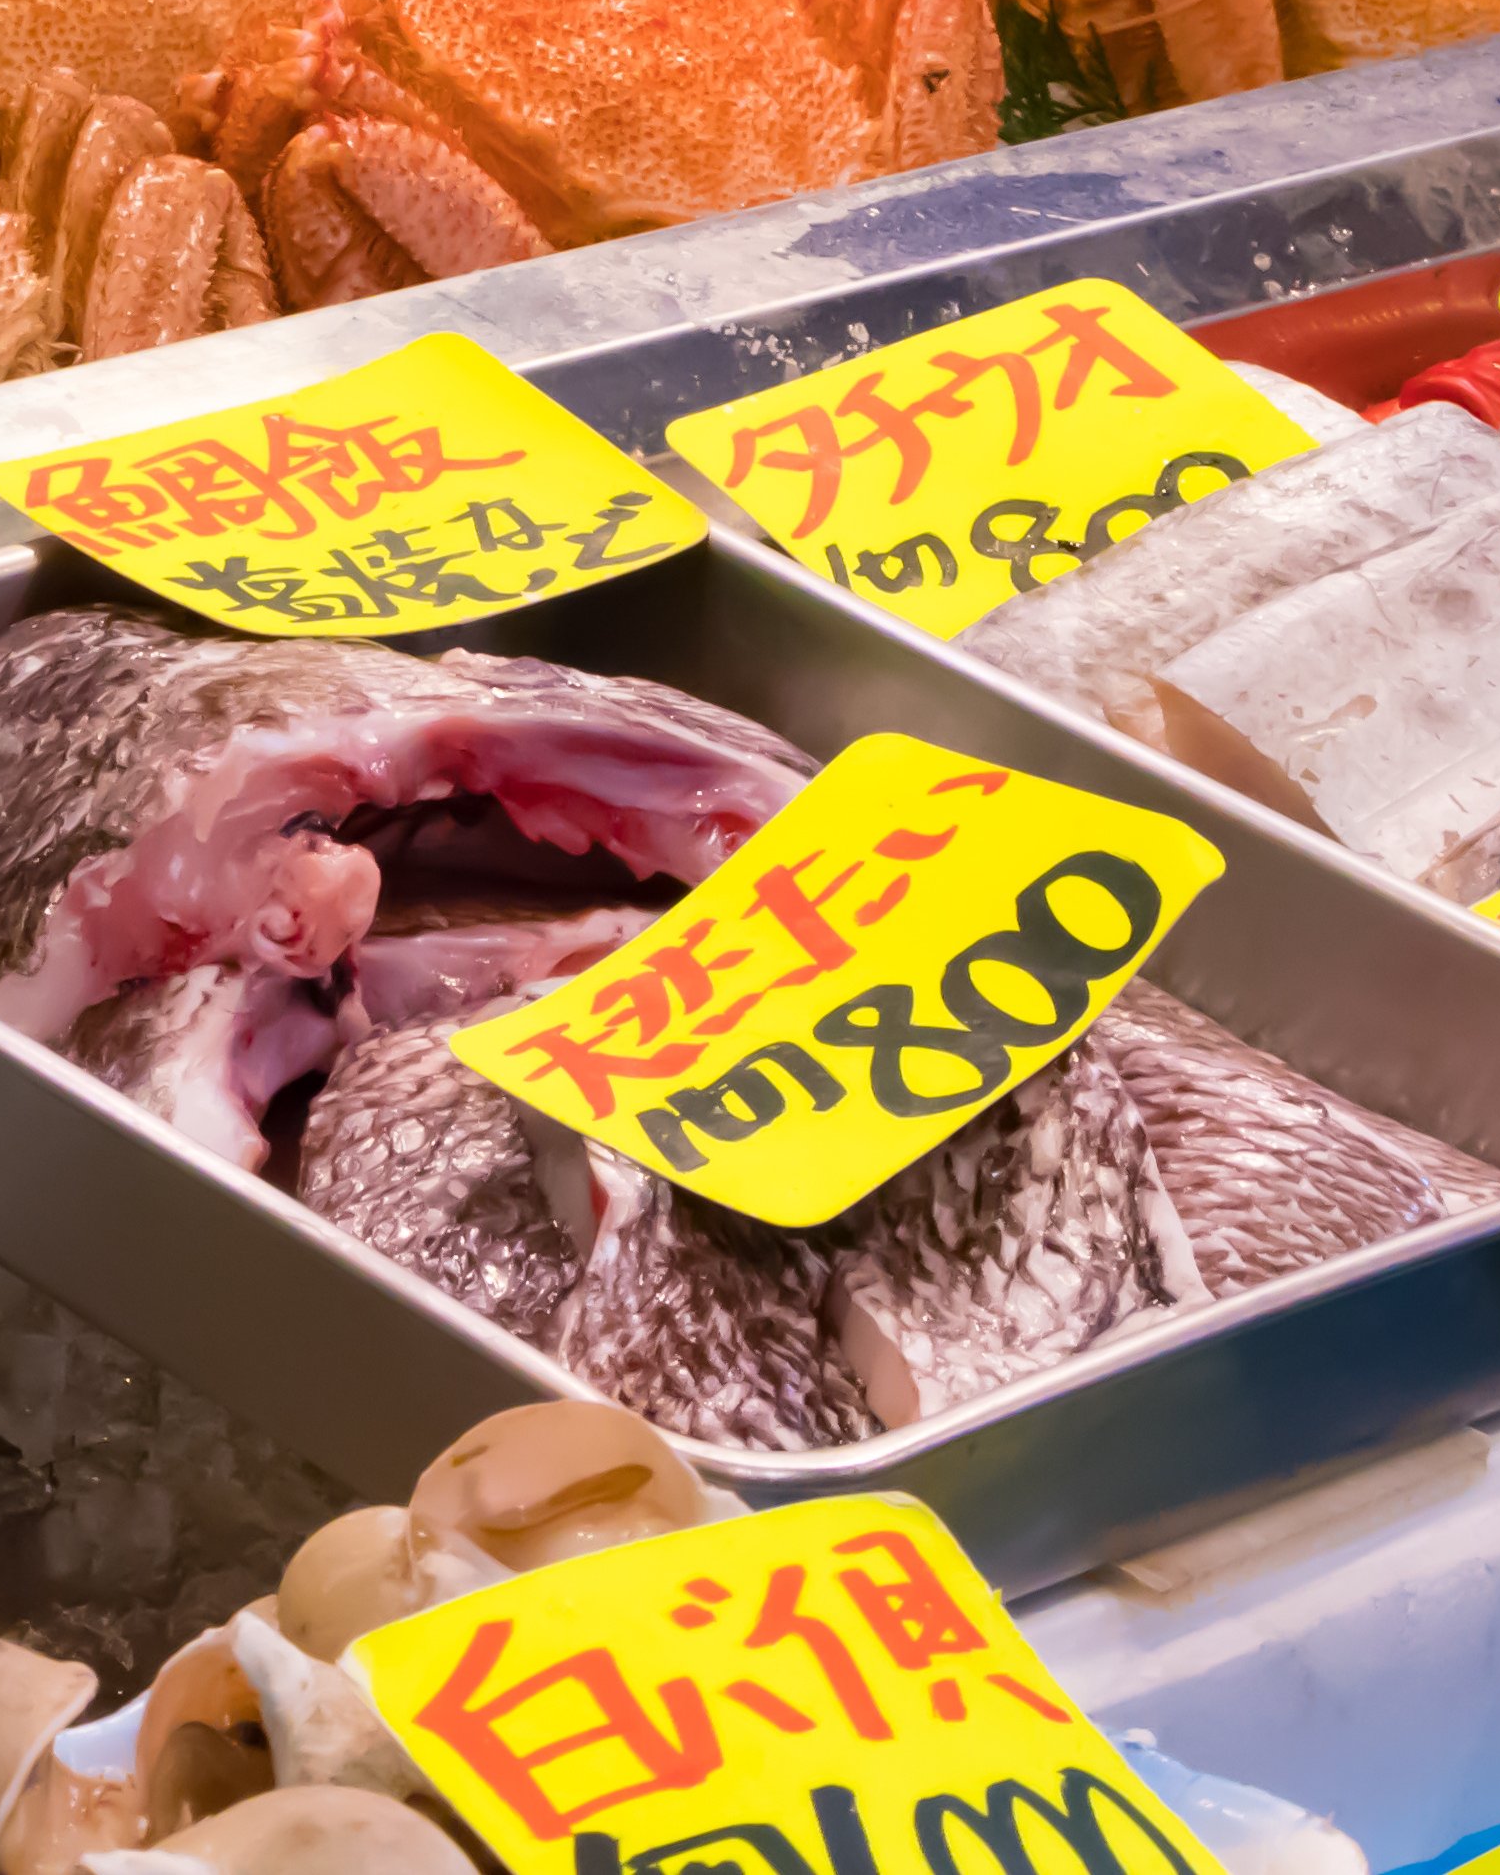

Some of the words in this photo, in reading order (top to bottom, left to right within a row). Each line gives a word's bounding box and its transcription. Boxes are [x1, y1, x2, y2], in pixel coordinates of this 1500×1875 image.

[24, 414, 528, 556] 鯛飯
[724, 302, 1180, 541] タチウオ
[504, 770, 1012, 1121] 天然たい
[411, 1531, 1074, 1842] 白バイ貝
